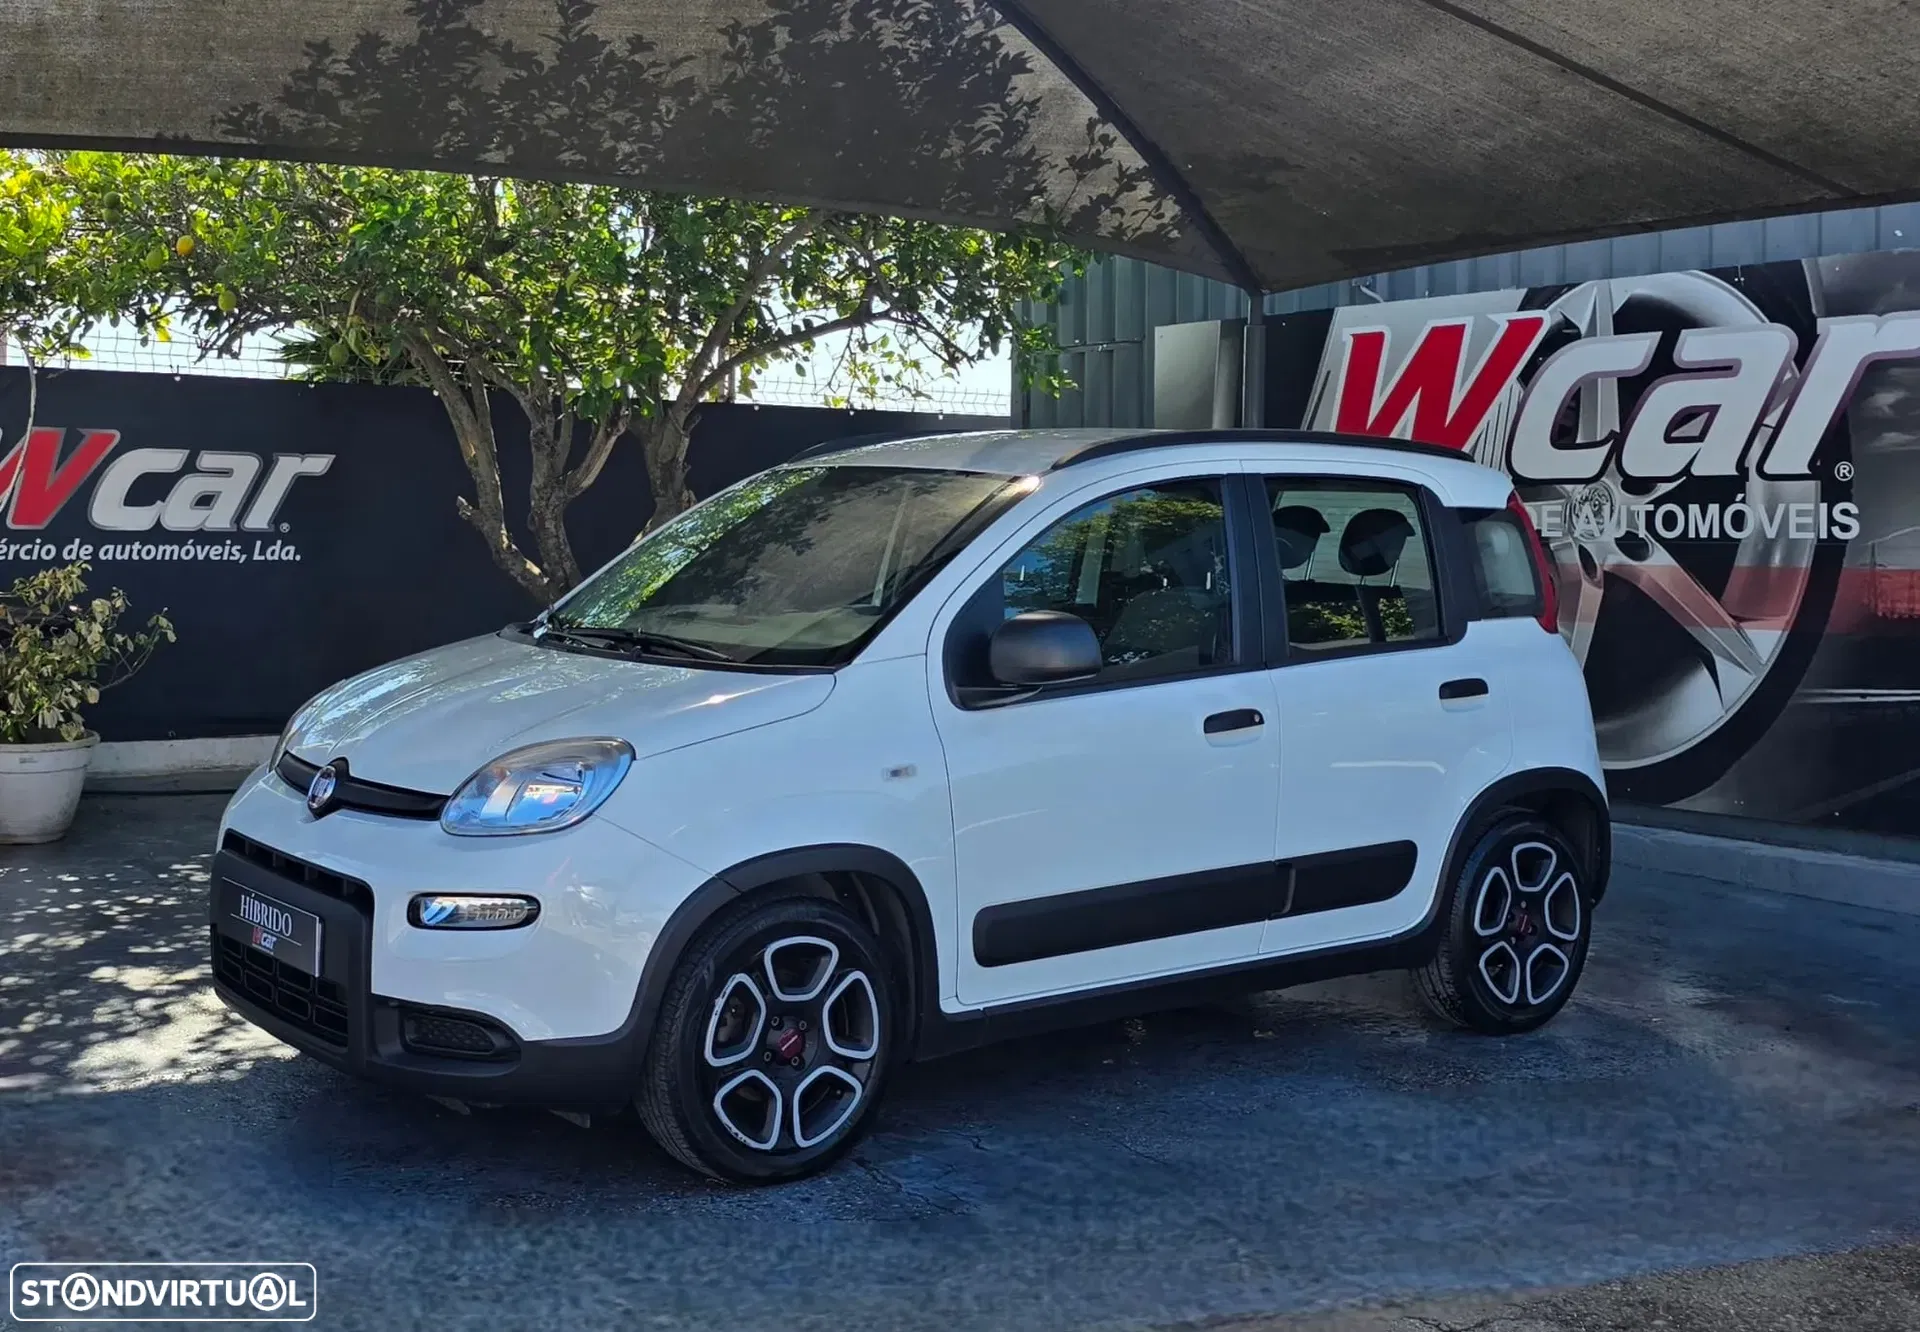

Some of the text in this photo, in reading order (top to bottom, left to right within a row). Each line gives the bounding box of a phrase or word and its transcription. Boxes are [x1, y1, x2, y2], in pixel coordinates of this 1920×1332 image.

[1574, 492, 1860, 540] AUTOMÓVEIS
[62, 538, 93, 560] de
[99, 538, 247, 563] automóveis,
[252, 540, 301, 561] Lda.
[240, 893, 292, 937] HÍBRIDO
